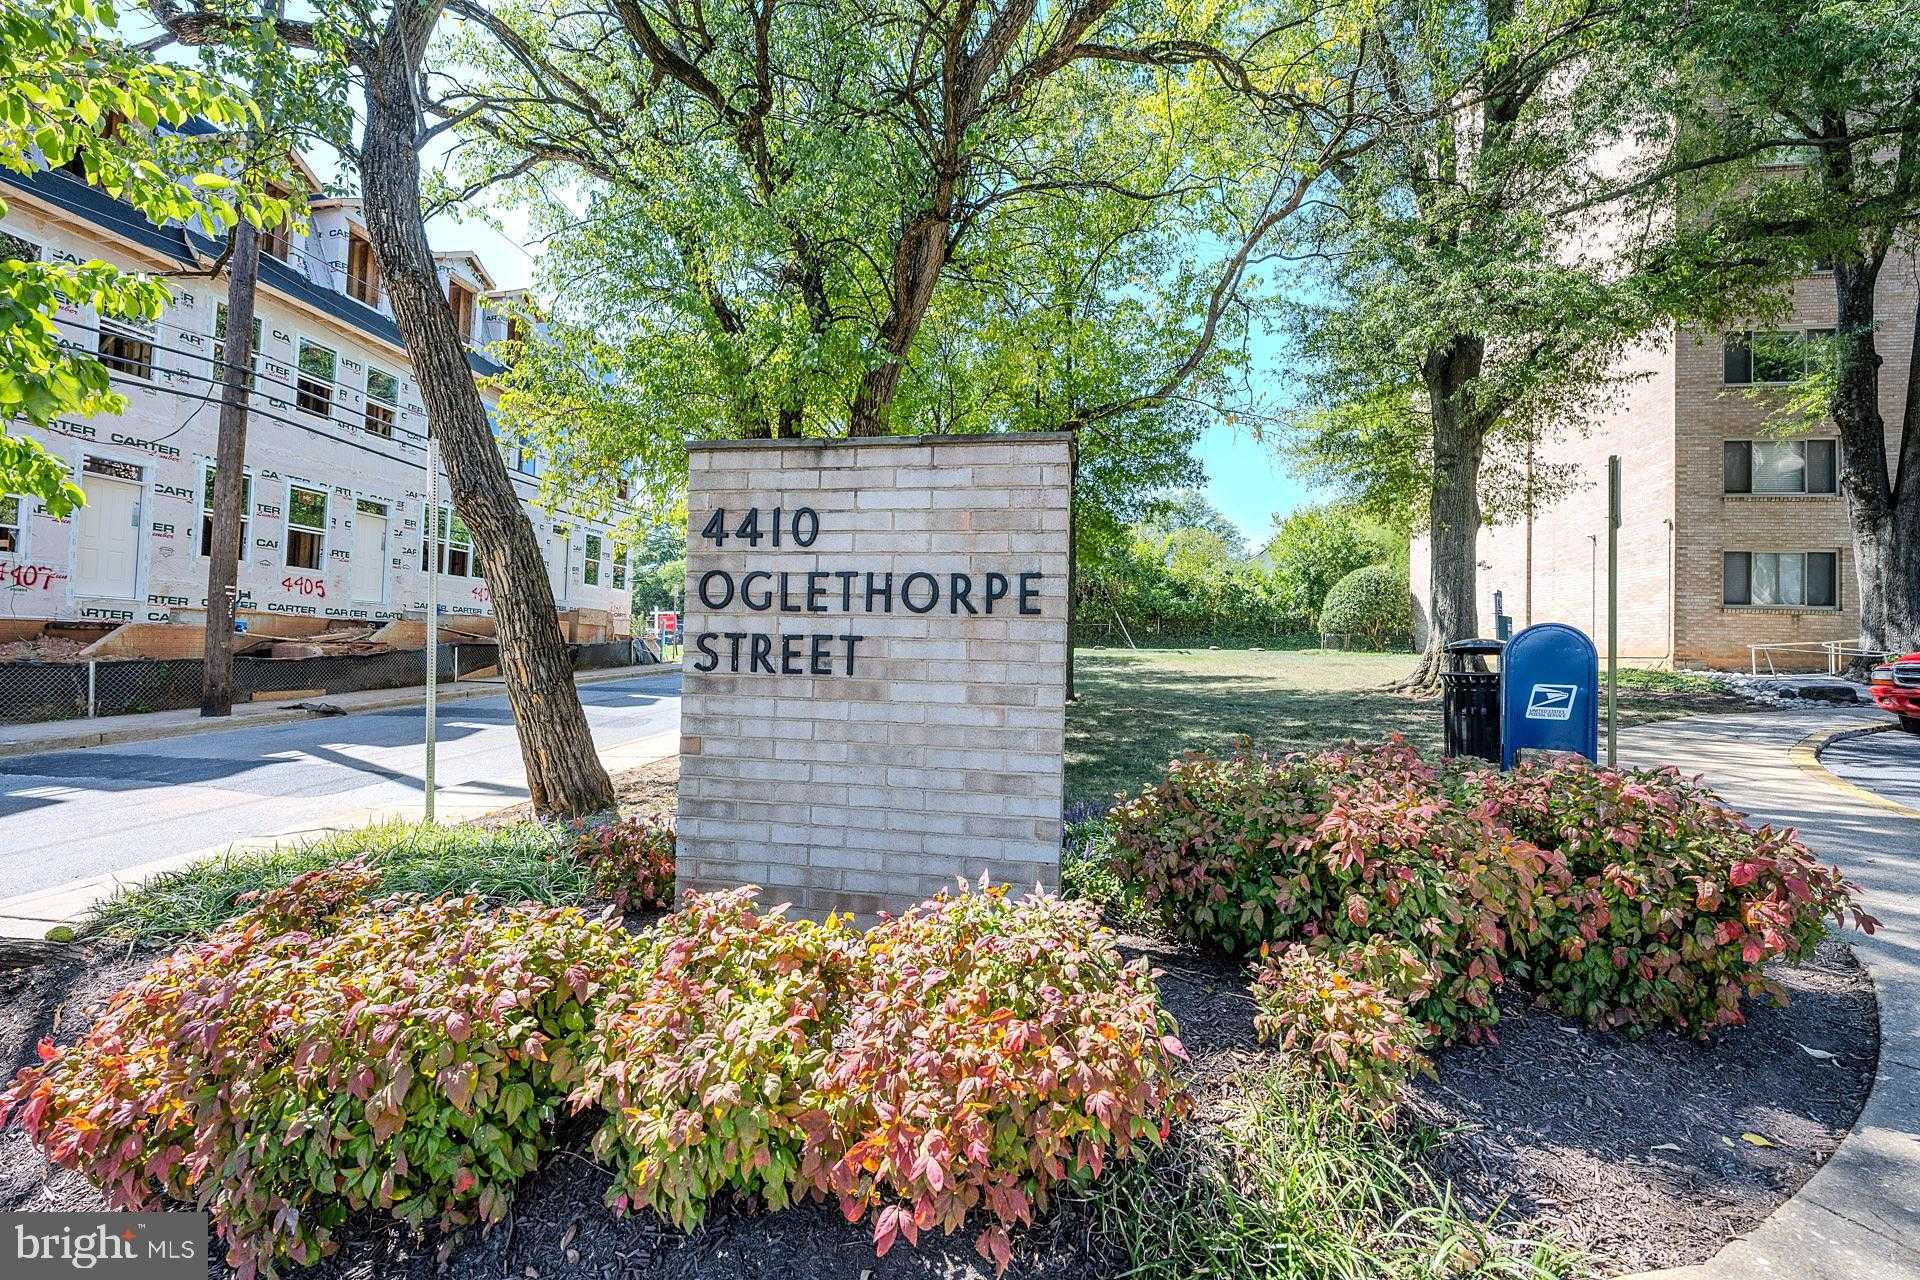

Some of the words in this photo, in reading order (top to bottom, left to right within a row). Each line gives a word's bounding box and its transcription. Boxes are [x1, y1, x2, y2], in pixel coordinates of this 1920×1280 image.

[111, 433, 180, 457] CARTER
[701, 506, 820, 548] 4410
[281, 576, 327, 599] 4405
[698, 570, 1043, 615] OGLETHORPE
[267, 603, 317, 615] CARTER
[693, 632, 863, 677] STREET
